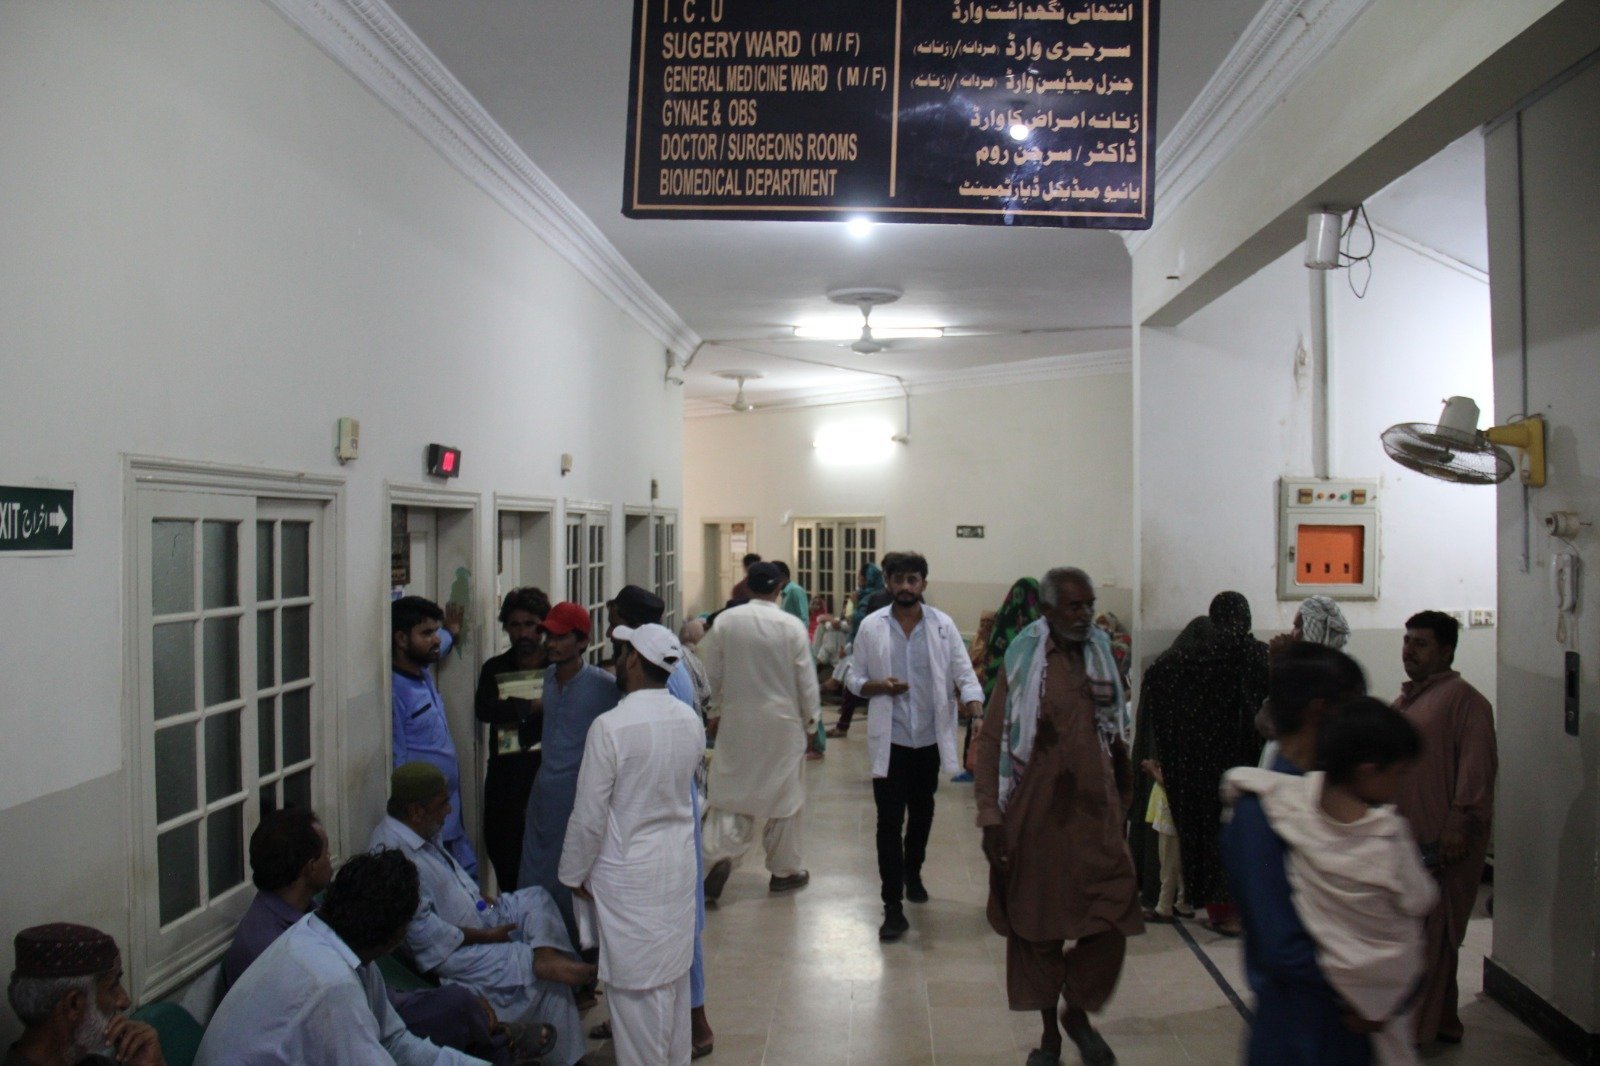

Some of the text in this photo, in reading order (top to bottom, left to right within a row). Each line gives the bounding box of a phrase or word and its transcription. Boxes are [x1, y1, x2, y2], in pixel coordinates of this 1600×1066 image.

[662, 31, 741, 59] SUGERY
[745, 30, 801, 58] WARD
[664, 65, 723, 92] GENERAL
[726, 66, 787, 92] MEDICINE
[790, 64, 828, 92] WARD
[662, 98, 758, 127] GYNAE & OBS
[807, 132, 858, 161] ROOMS
[660, 168, 838, 196] BIOMEDICAL DEPARTMENT
[0, 502, 20, 540] XIT
